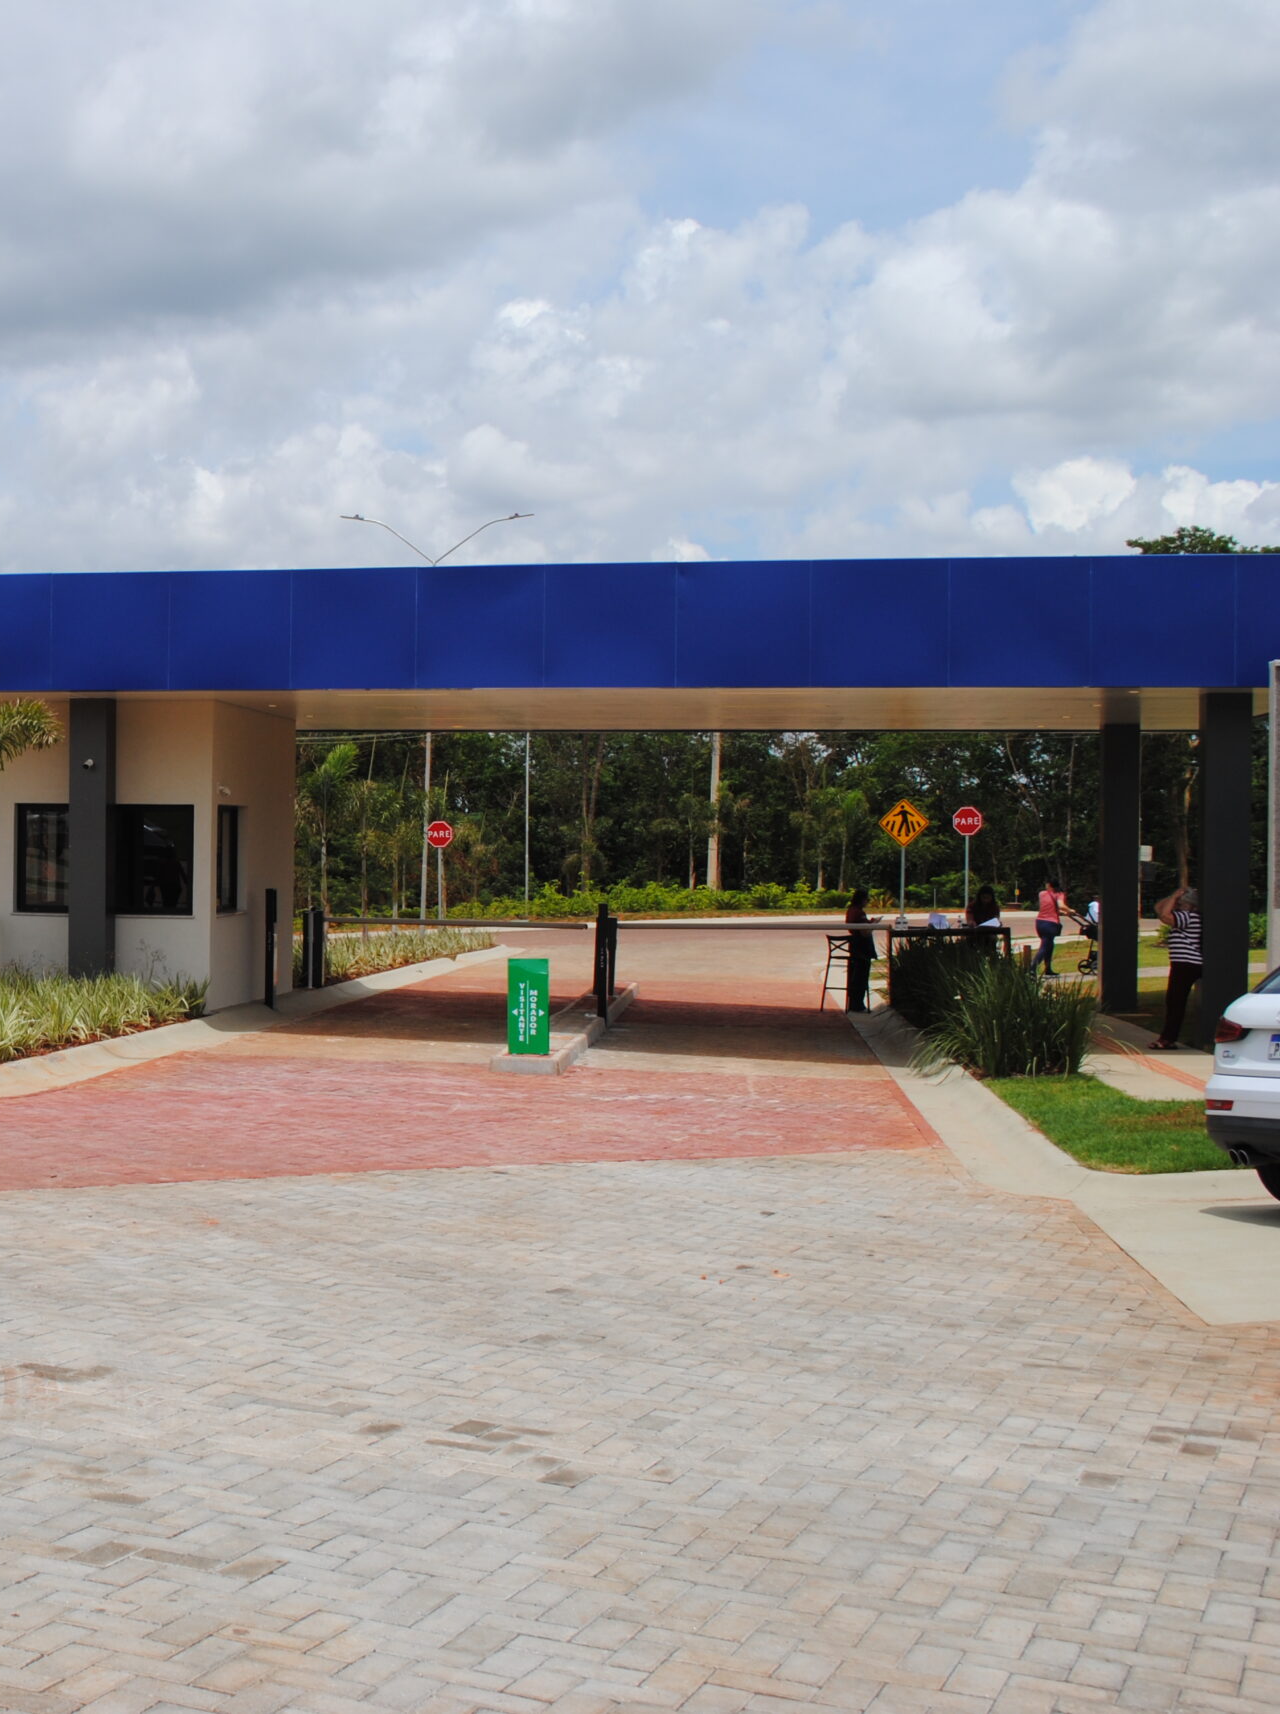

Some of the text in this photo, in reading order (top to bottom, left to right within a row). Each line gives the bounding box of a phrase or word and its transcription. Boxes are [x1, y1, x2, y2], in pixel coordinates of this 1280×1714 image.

[954, 817, 980, 825] PARE
[428, 830, 450, 838] PARE
[529, 990, 538, 1036] MORADOR
